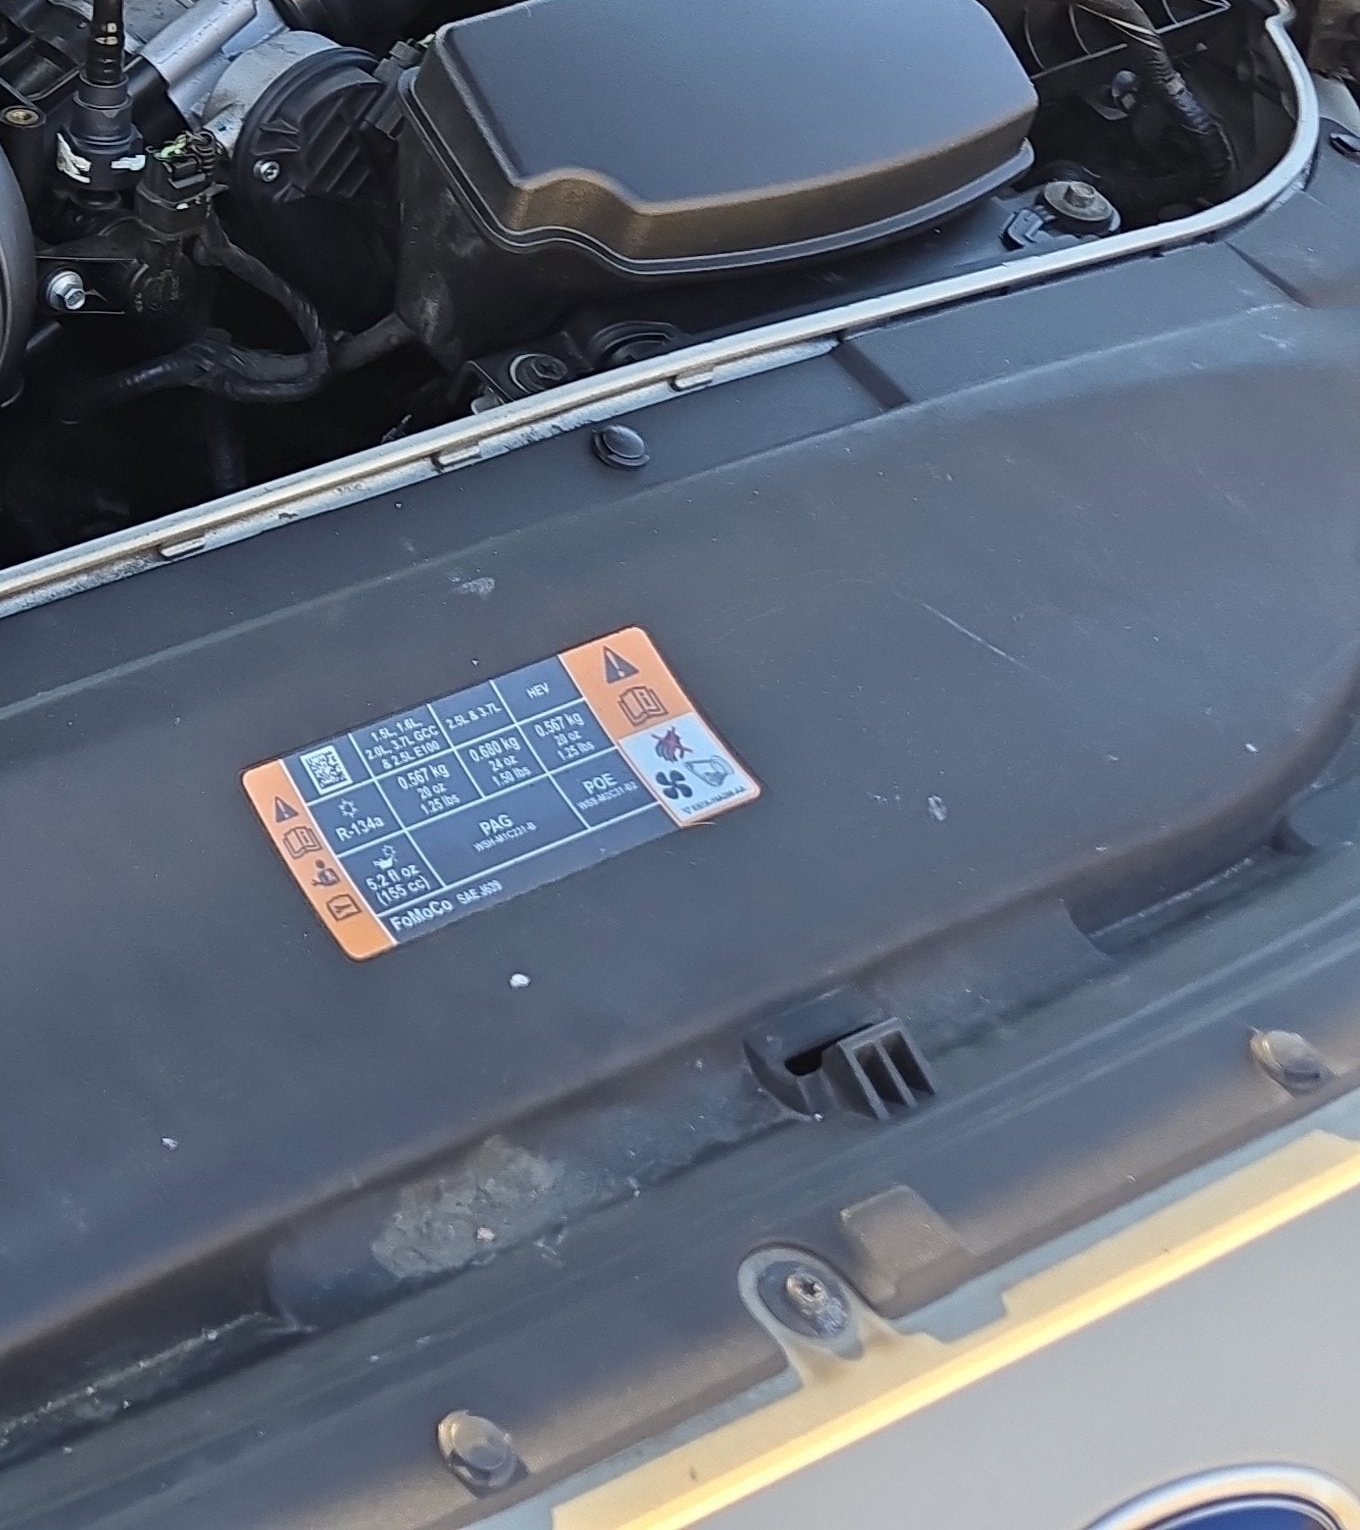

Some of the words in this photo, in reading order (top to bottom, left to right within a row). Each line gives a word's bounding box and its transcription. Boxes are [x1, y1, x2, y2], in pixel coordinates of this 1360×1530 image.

[525, 682, 550, 699] HEV
[445, 714, 471, 730] 2.5L
[467, 710, 480, 721] &
[476, 702, 502, 717] 3.7L
[534, 715, 566, 738] 0.567
[563, 712, 585, 726] kg
[390, 734, 416, 751] 3.7L
[413, 724, 440, 742] GCC
[553, 733, 569, 747] 20
[567, 730, 582, 741] oz
[381, 758, 393, 770] &
[390, 750, 417, 767] 2.5L
[412, 739, 441, 758] E100
[468, 740, 503, 763] 0.680
[498, 736, 522, 751] kg
[556, 744, 580, 761] 1.25
[575, 741, 596, 754] lbs
[488, 758, 504, 773] 24
[503, 755, 519, 766] oz
[397, 767, 430, 790] 0.567
[428, 764, 451, 778] kg
[491, 770, 515, 787] 1.50
[511, 766, 532, 779] lbs
[582, 772, 618, 795] POE
[416, 785, 433, 801] 20
[431, 782, 447, 794] oz
[420, 797, 444, 815] 1.25
[440, 794, 461, 807] lbs
[335, 816, 385, 842] R-134a
[479, 814, 514, 836] PAG
[386, 868, 402, 883] fl
[400, 864, 421, 878] oz
[407, 875, 432, 893] cc)
[455, 888, 482, 905] SAE
[389, 899, 454, 932] FoMoCo
